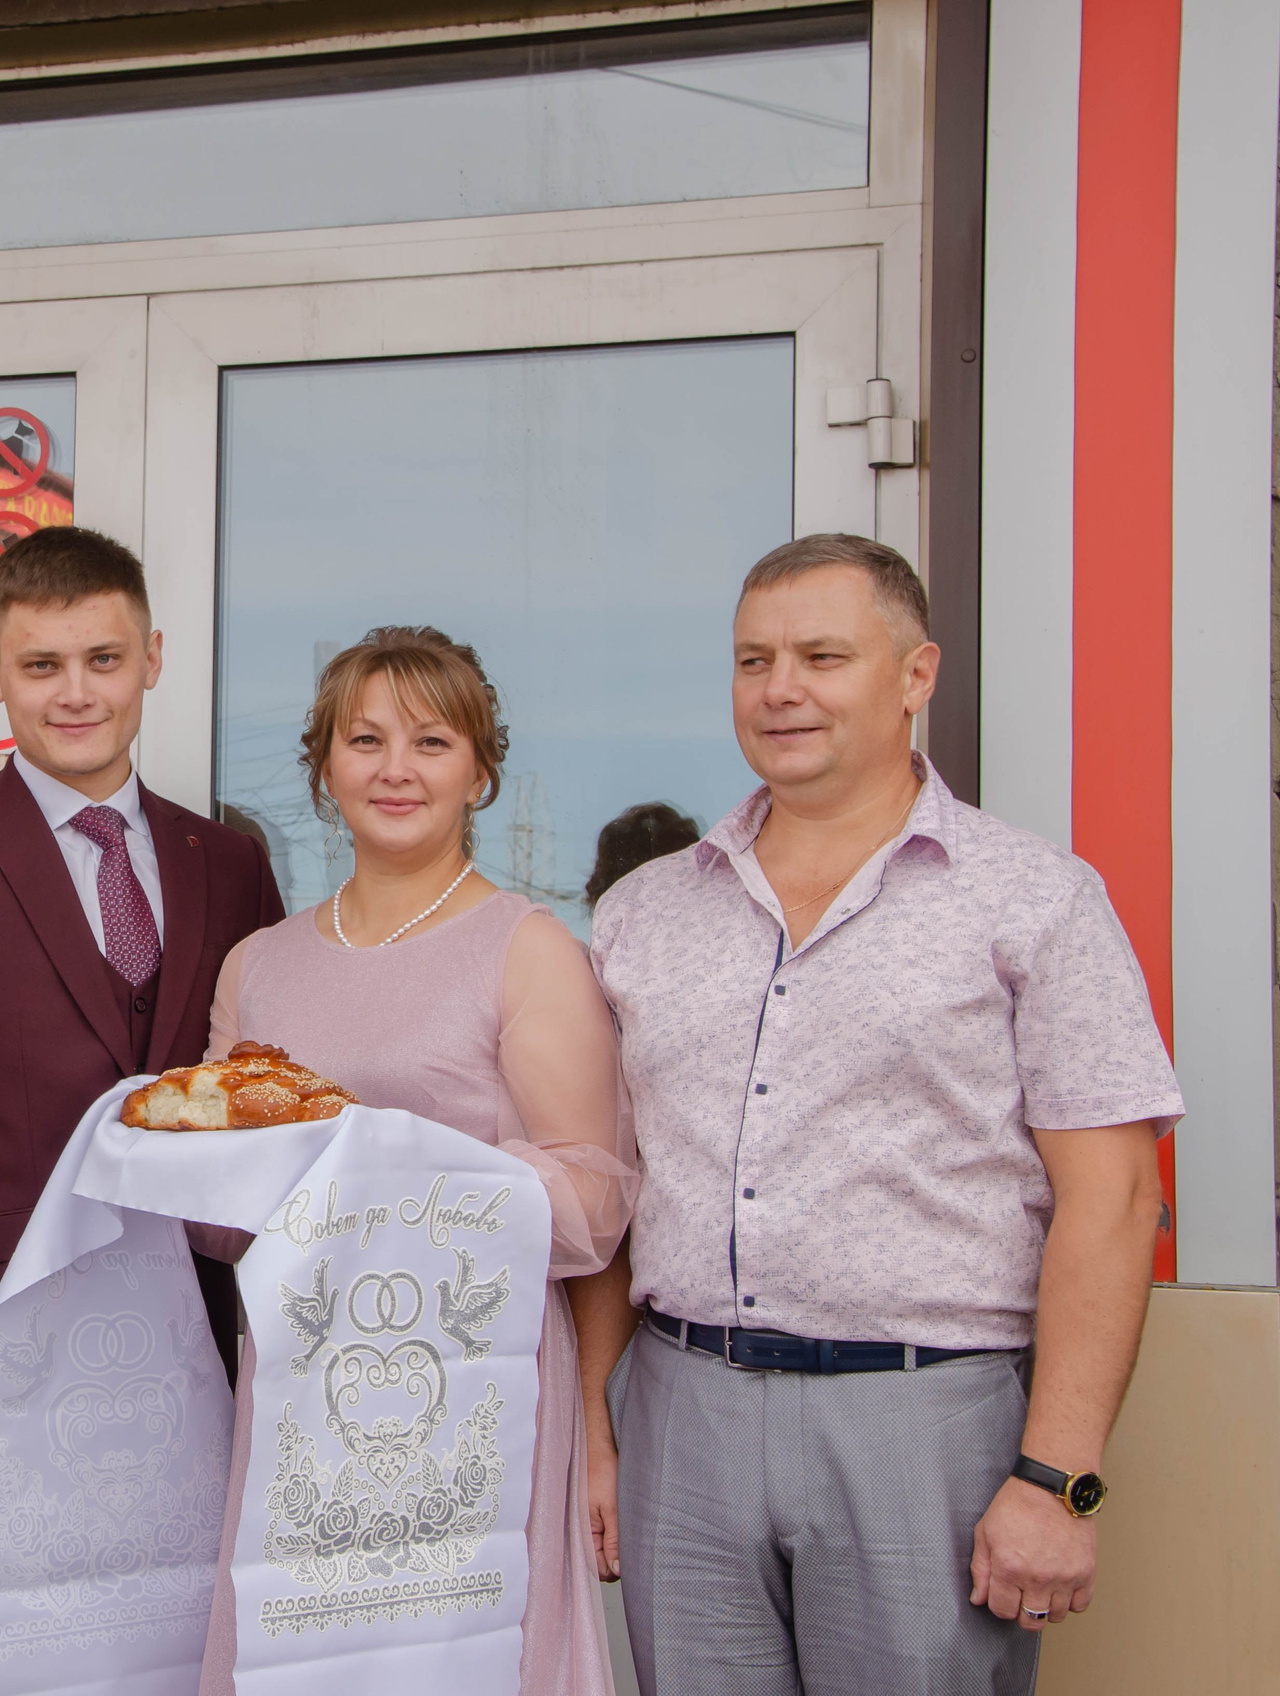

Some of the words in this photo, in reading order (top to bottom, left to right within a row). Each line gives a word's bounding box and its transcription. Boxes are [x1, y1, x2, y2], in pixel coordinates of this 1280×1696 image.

[264, 1180, 358, 1255] Совет
[360, 1205, 392, 1249] да
[398, 1173, 512, 1248] Любовь
